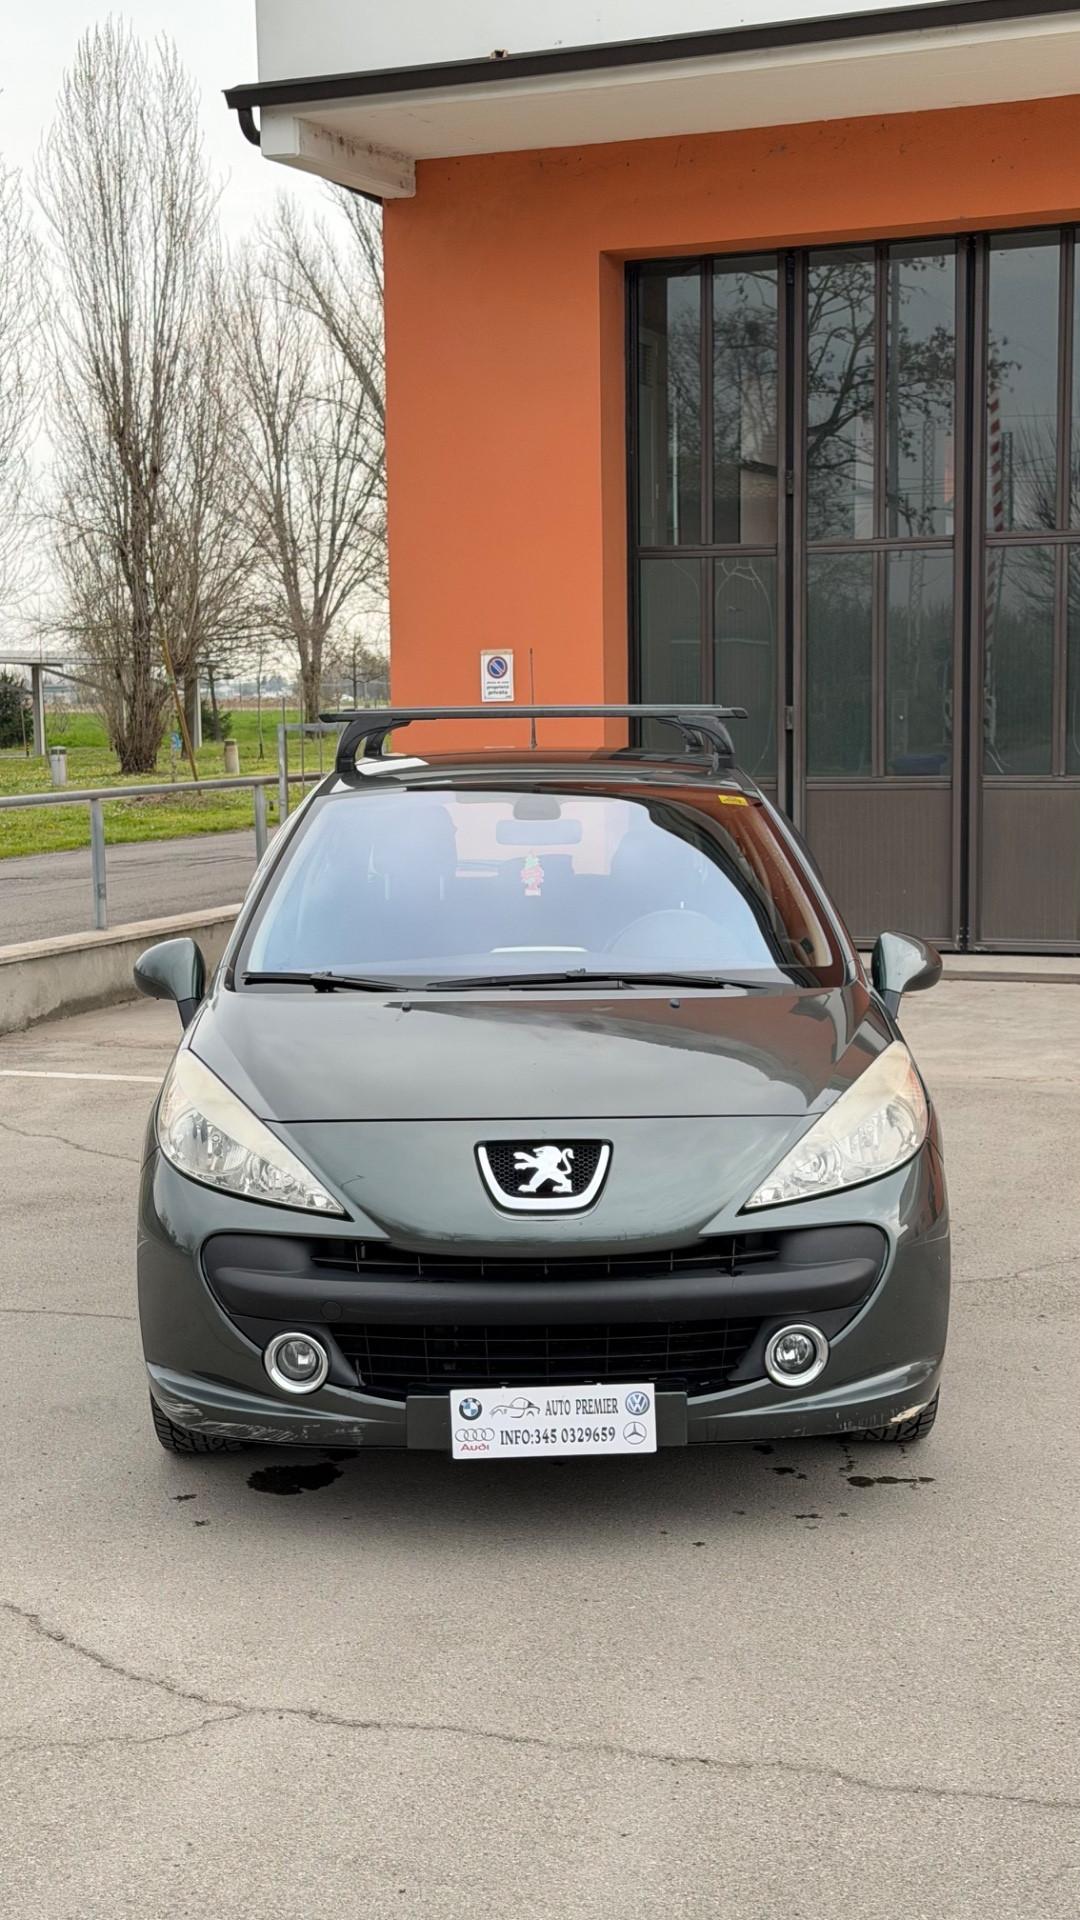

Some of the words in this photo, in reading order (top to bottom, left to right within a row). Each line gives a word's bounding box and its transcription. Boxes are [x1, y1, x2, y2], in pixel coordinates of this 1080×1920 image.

[545, 1399, 570, 1416] AUTO
[575, 1397, 619, 1415] PREMIER
[500, 1428, 557, 1446] INFO:345
[561, 1426, 616, 1444] 0329659
[460, 1443, 490, 1452] Audi
